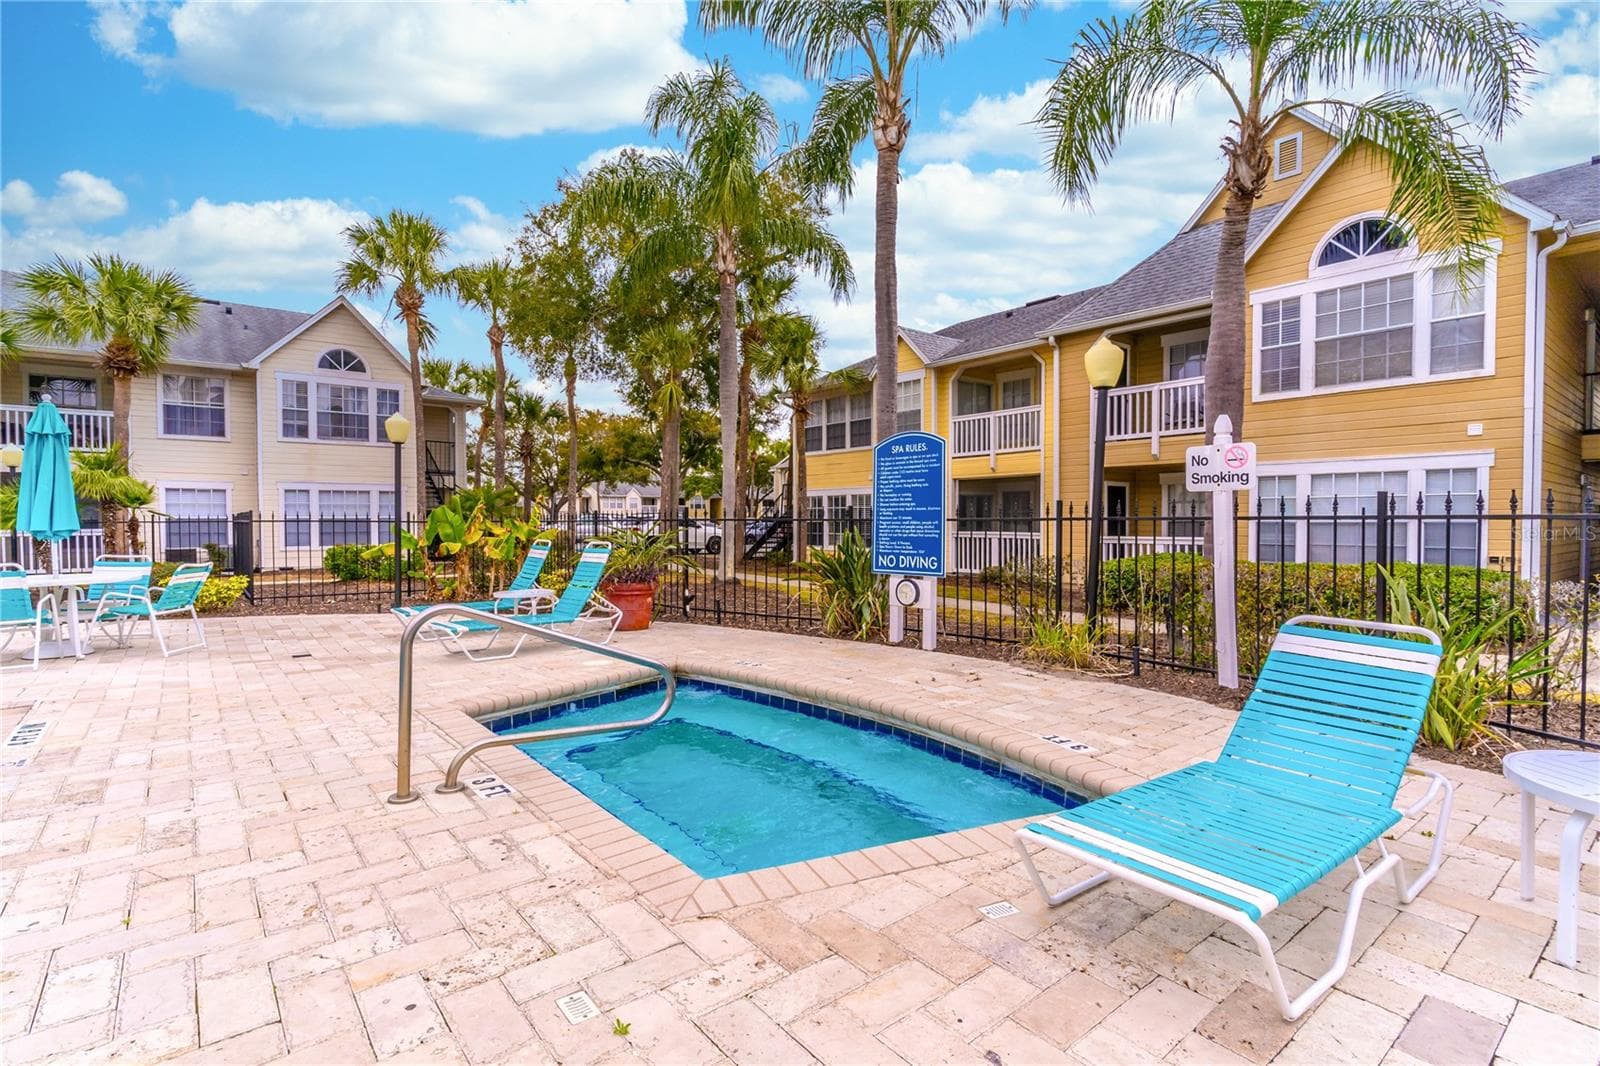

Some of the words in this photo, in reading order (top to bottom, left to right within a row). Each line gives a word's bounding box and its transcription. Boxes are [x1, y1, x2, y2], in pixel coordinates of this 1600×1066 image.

[891, 445, 904, 454] SPA
[1191, 454, 1209, 467] No
[1191, 470, 1249, 485] Smoking
[878, 554, 896, 567] NO
[899, 555, 938, 569] DIVING
[1041, 735, 1071, 744] FT
[471, 777, 496, 785] 3
[480, 784, 511, 797] FT
